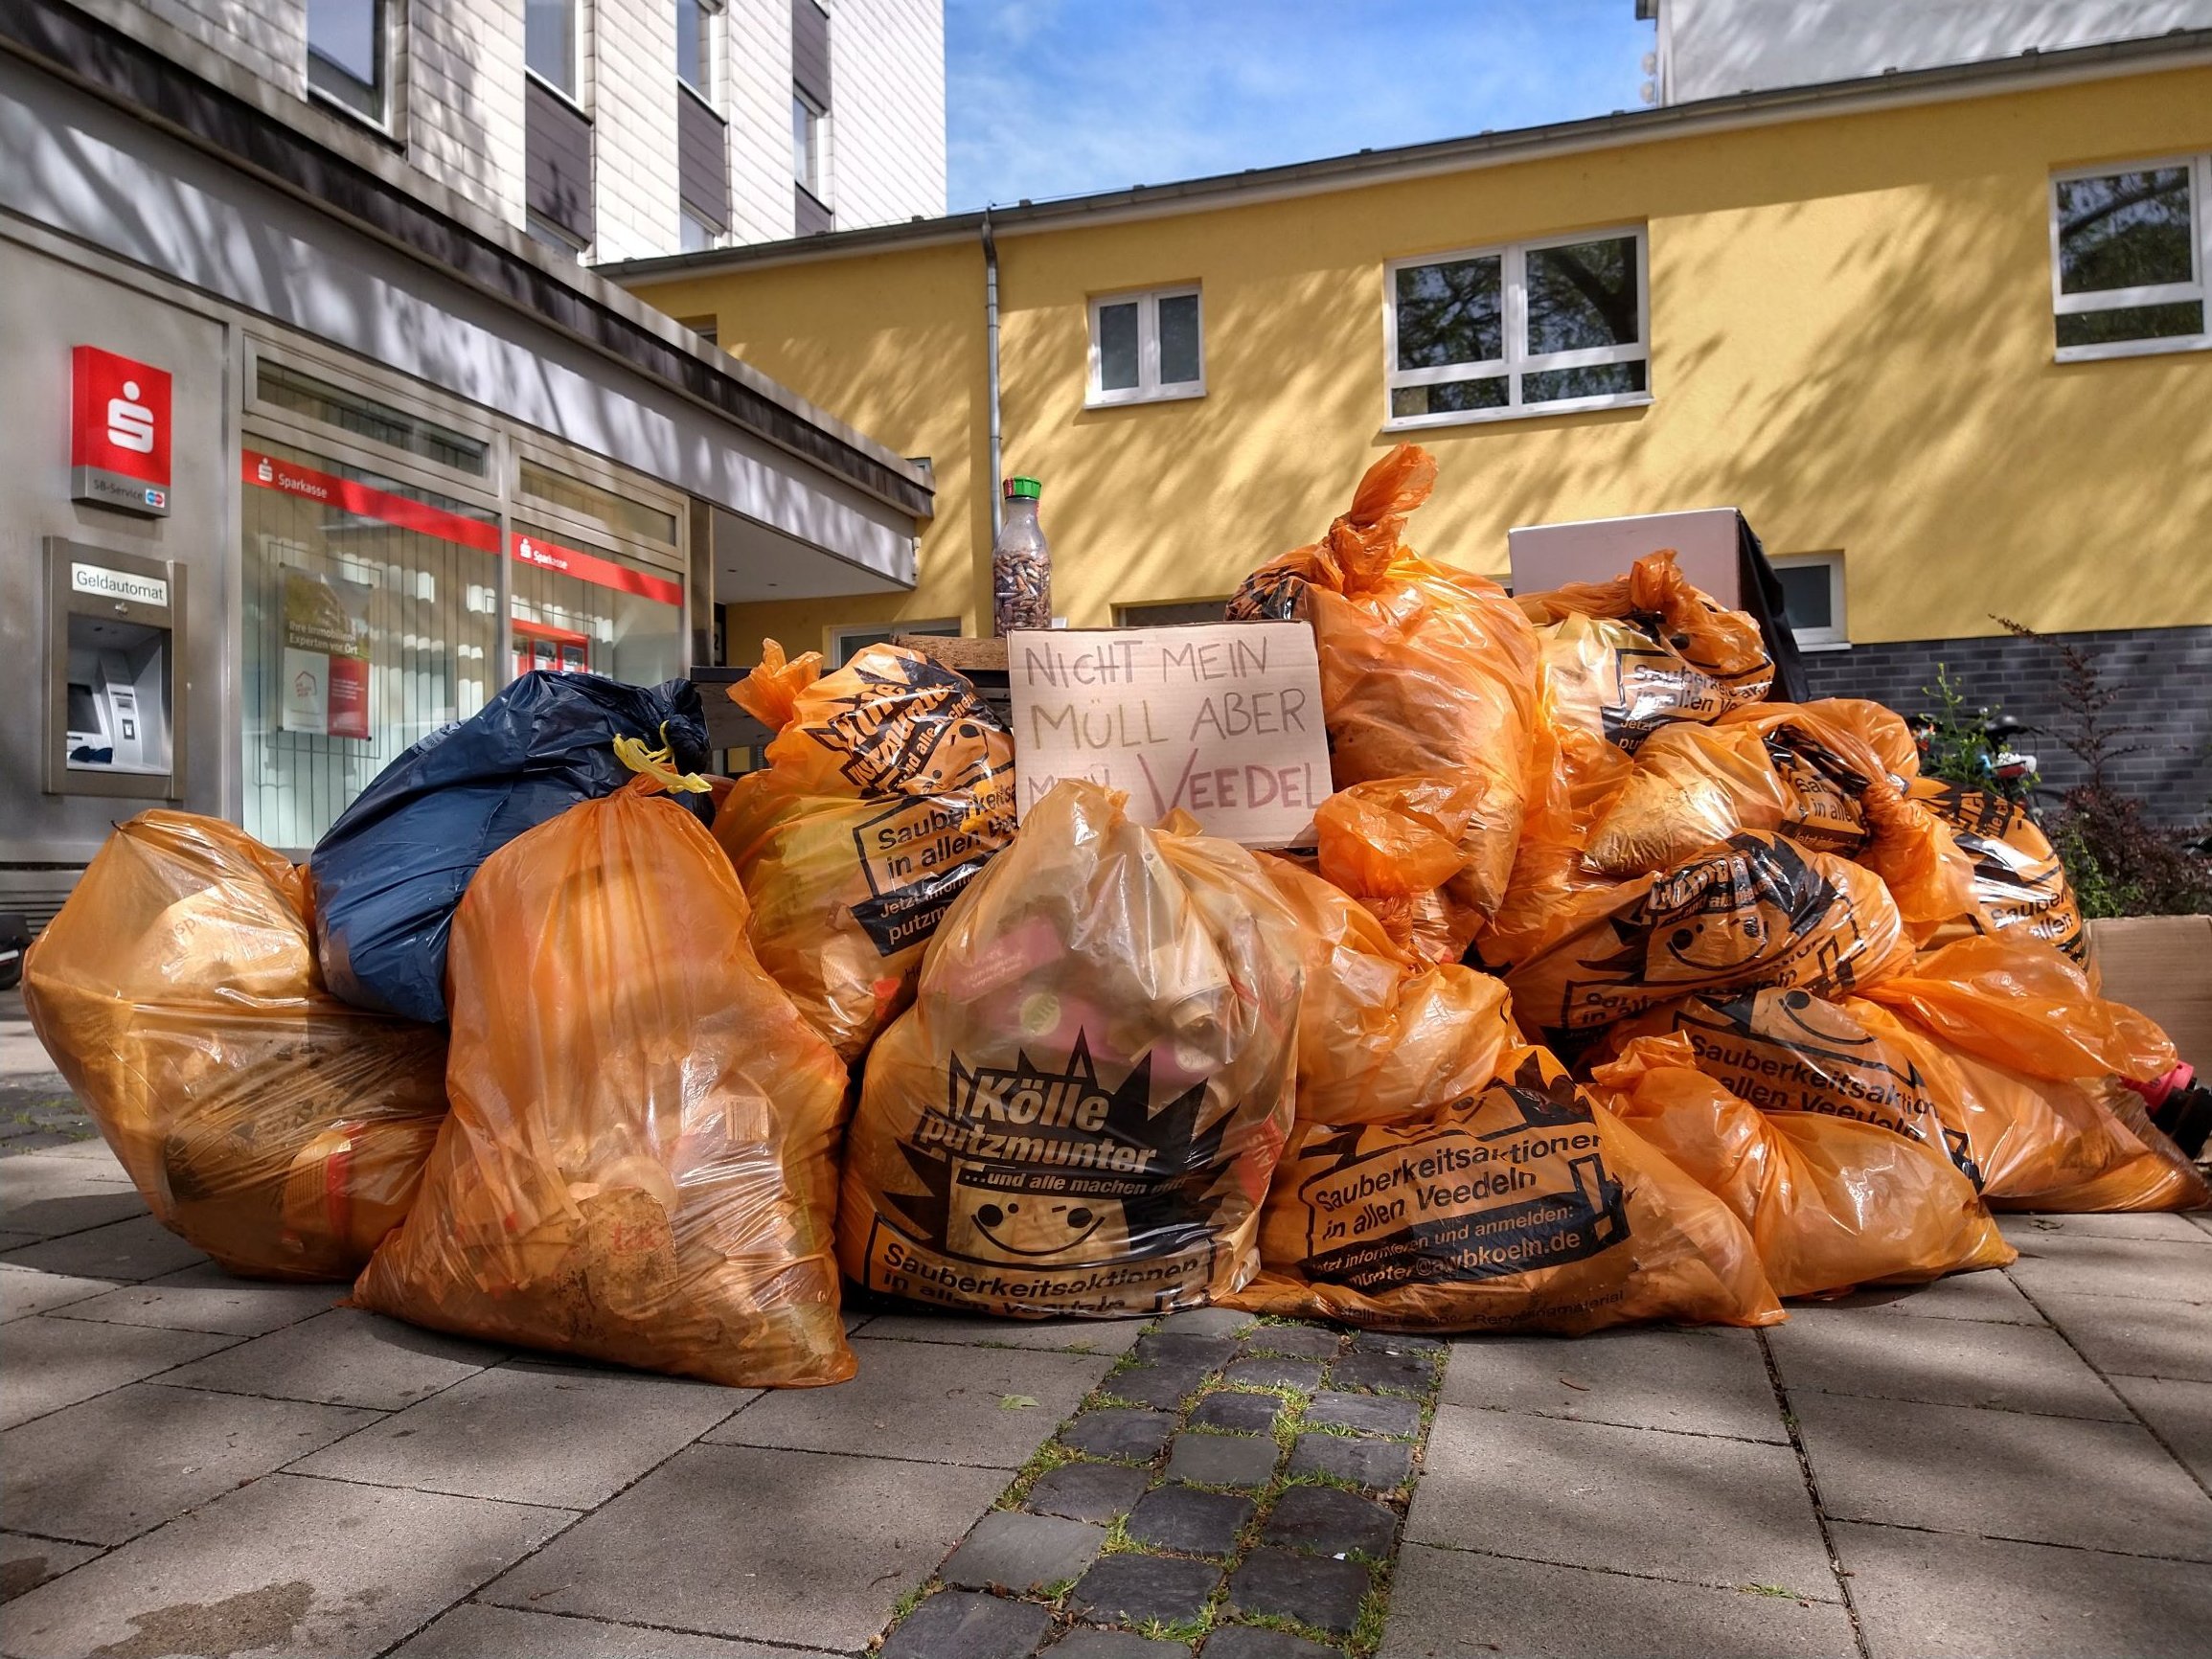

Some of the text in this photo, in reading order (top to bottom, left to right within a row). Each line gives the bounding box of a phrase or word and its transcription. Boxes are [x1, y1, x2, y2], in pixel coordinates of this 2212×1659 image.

[93, 480, 144, 500] SB-Service
[278, 473, 328, 498] Sparkasse
[76, 571, 164, 602] Geldautomat
[289, 632, 329, 649] Experten
[344, 643, 358, 655] Ort
[1162, 636, 1267, 683] MEIN
[1030, 689, 1306, 750] MÜLL ABER
[887, 830, 982, 879] in allen
[969, 1075, 1110, 1132] Kölle
[919, 1115, 1158, 1175] putzmunter
[1029, 1174, 1066, 1192] alle
[1069, 1177, 1148, 1196] machen
[1322, 1167, 1537, 1240] in allen Veedeln
[1434, 1223, 1470, 1246] und
[1474, 1203, 1575, 1238] anmelden:
[883, 1270, 908, 1291] in
